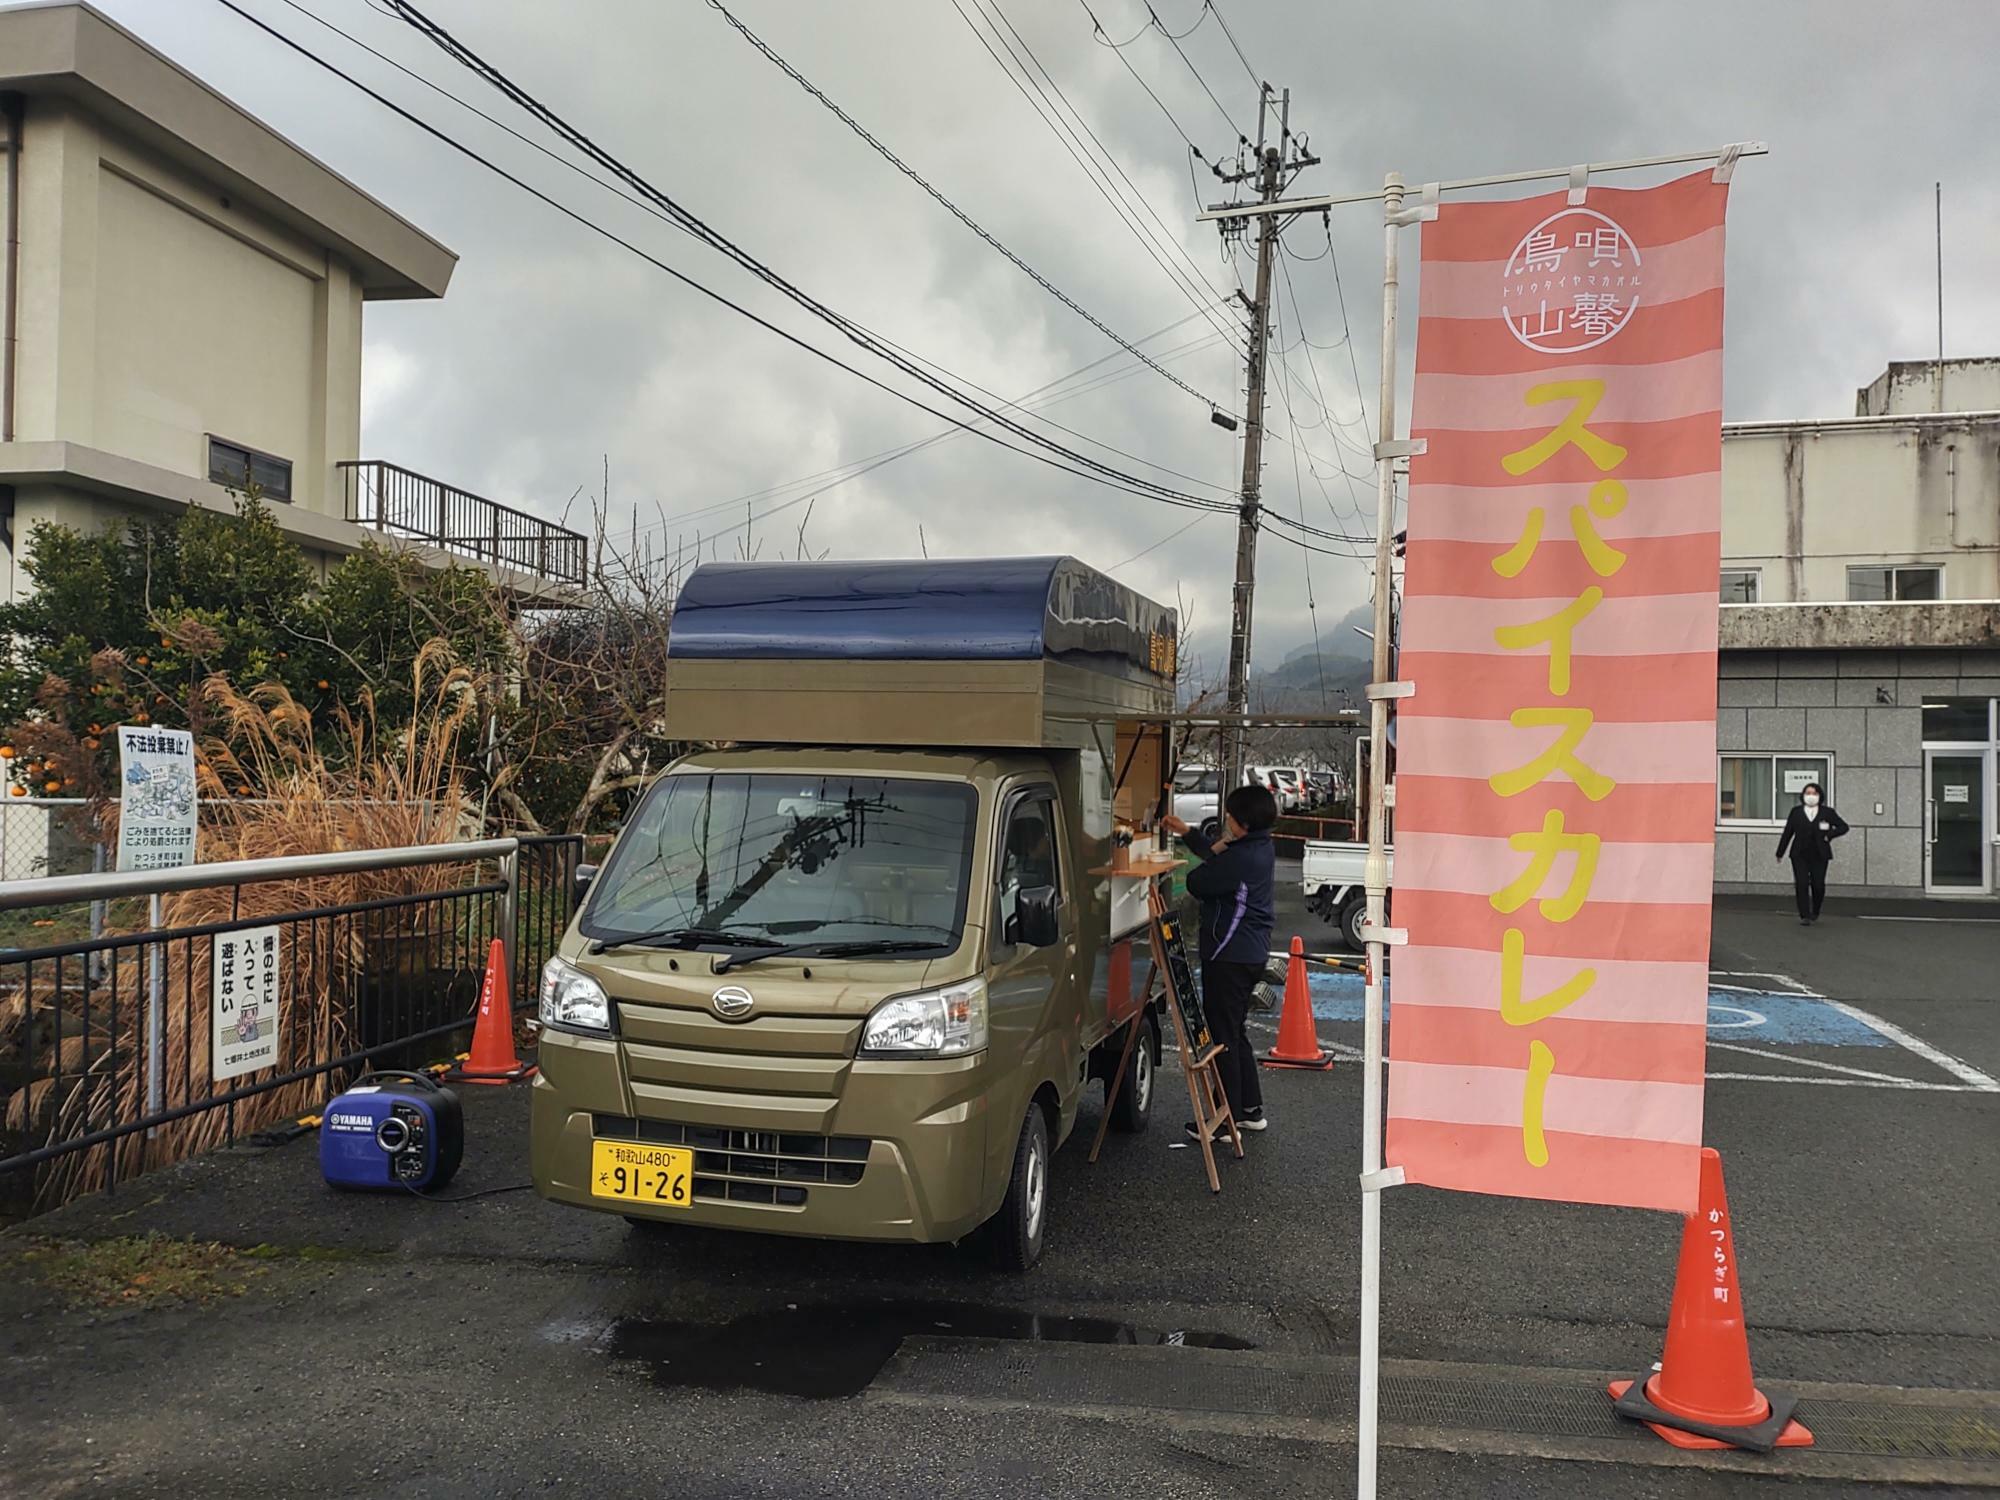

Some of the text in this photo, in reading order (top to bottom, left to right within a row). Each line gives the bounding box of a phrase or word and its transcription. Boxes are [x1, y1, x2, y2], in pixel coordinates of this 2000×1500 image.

[1515, 228, 1622, 274] 鳥唄
[1503, 275, 1641, 297] トリウタイヤマカオル
[1521, 292, 1623, 340] 山馨
[1490, 378, 1628, 1168] スパイスカレー
[221, 943, 234, 1013] 遊ばない
[243, 939, 255, 990] 入って
[263, 936, 274, 1004] 柵の中に
[340, 1114, 373, 1126] YAMAHA
[614, 1167, 685, 1200] 91-26
[1708, 1208, 1729, 1303] かつらぎ町
